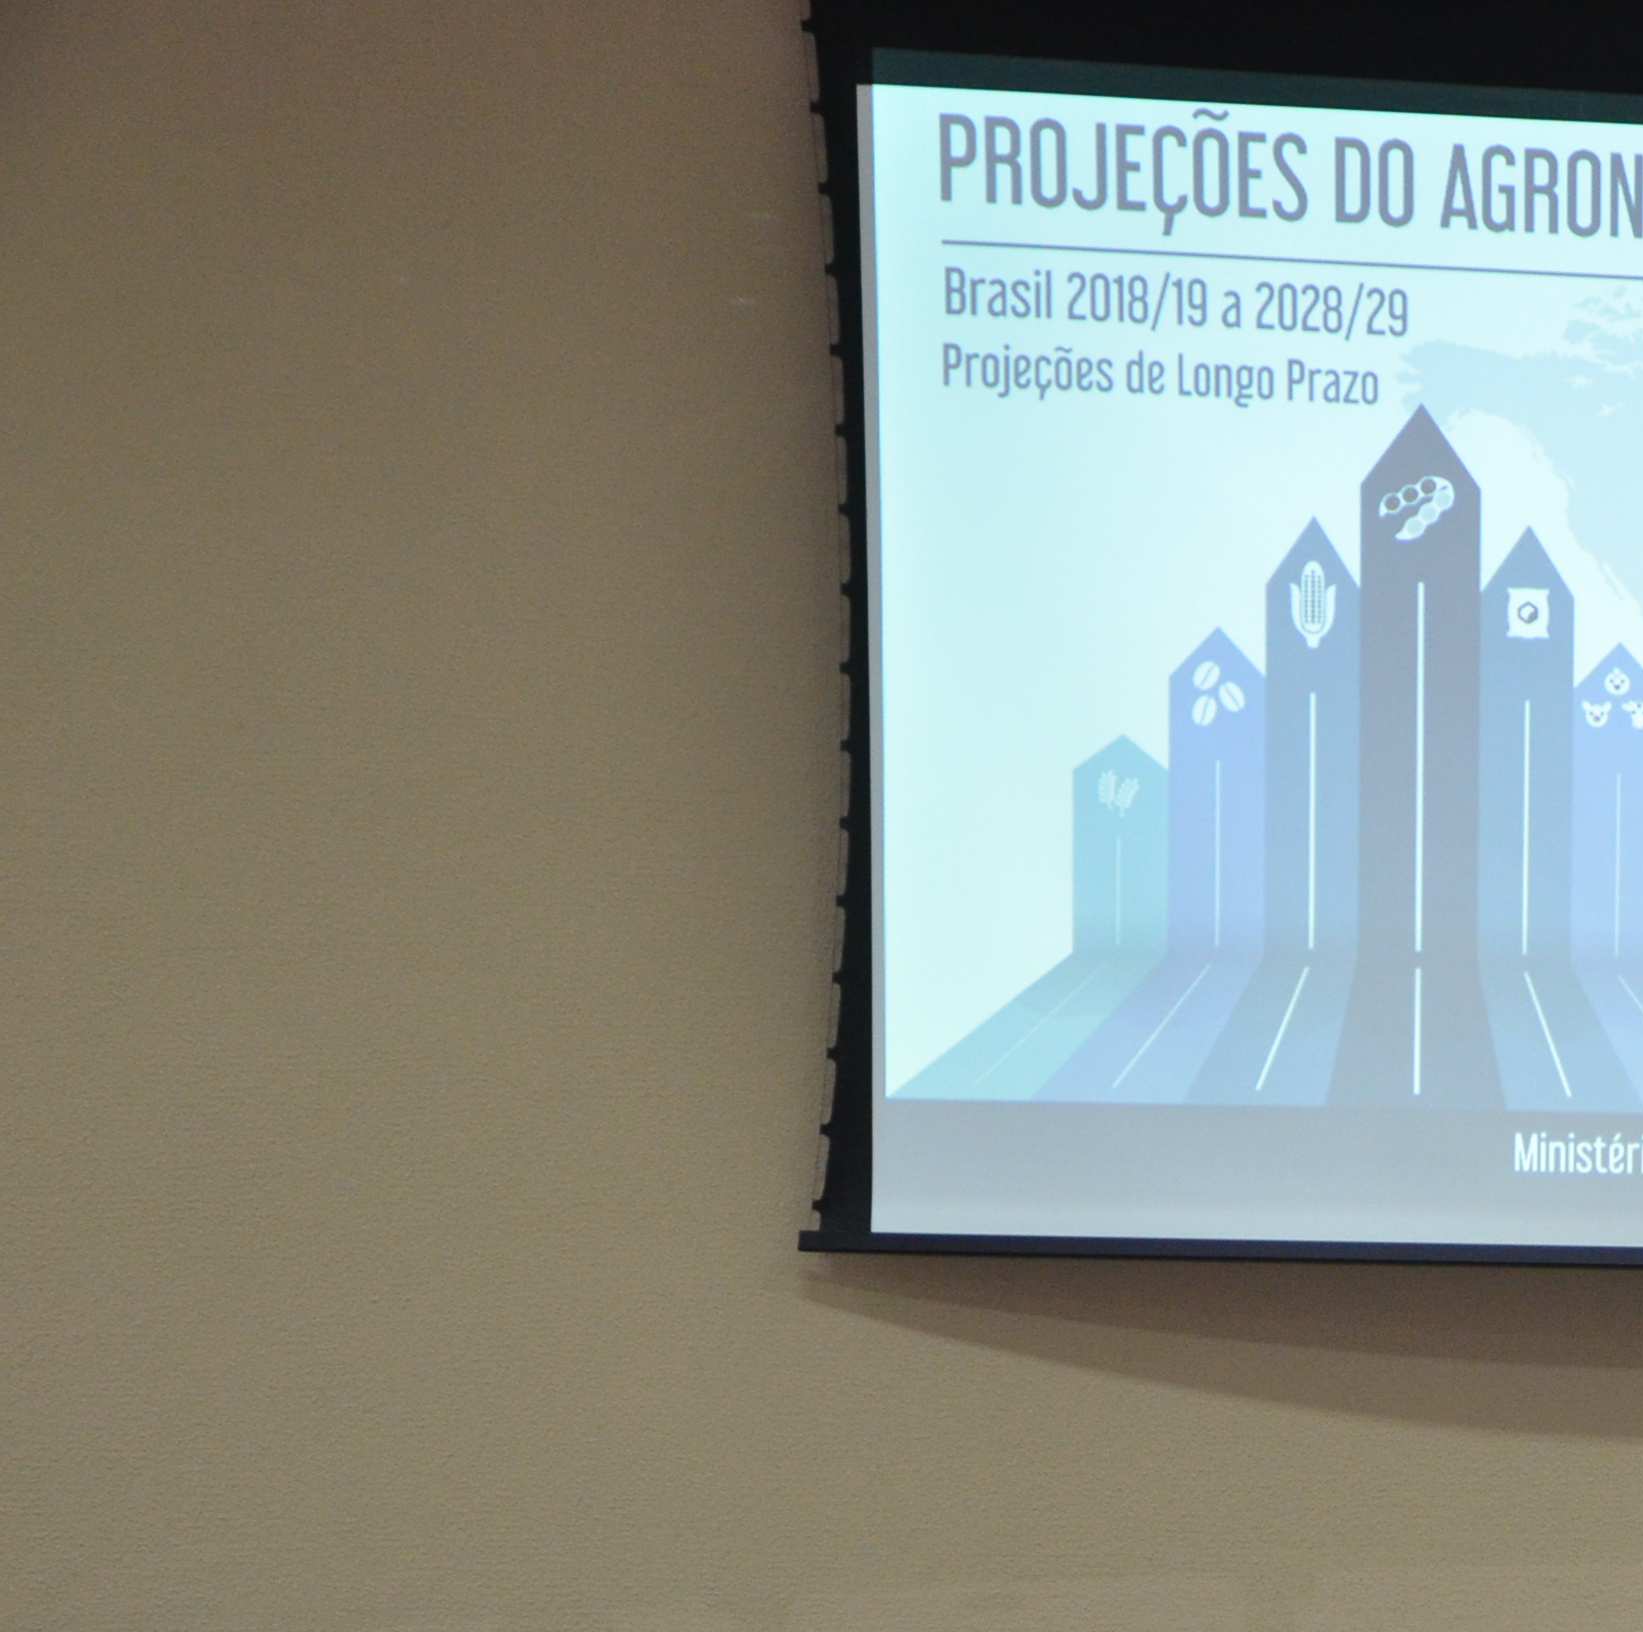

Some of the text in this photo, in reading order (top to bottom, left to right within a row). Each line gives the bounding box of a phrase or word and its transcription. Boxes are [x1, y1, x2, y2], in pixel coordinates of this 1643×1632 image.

[938, 107, 1309, 236] PROJEÇÕES
[1334, 136, 1415, 229] DO
[944, 266, 1408, 342] Brasil 2018/19 a 2028/29
[942, 341, 1379, 409] Projeções de Longo Prazo
